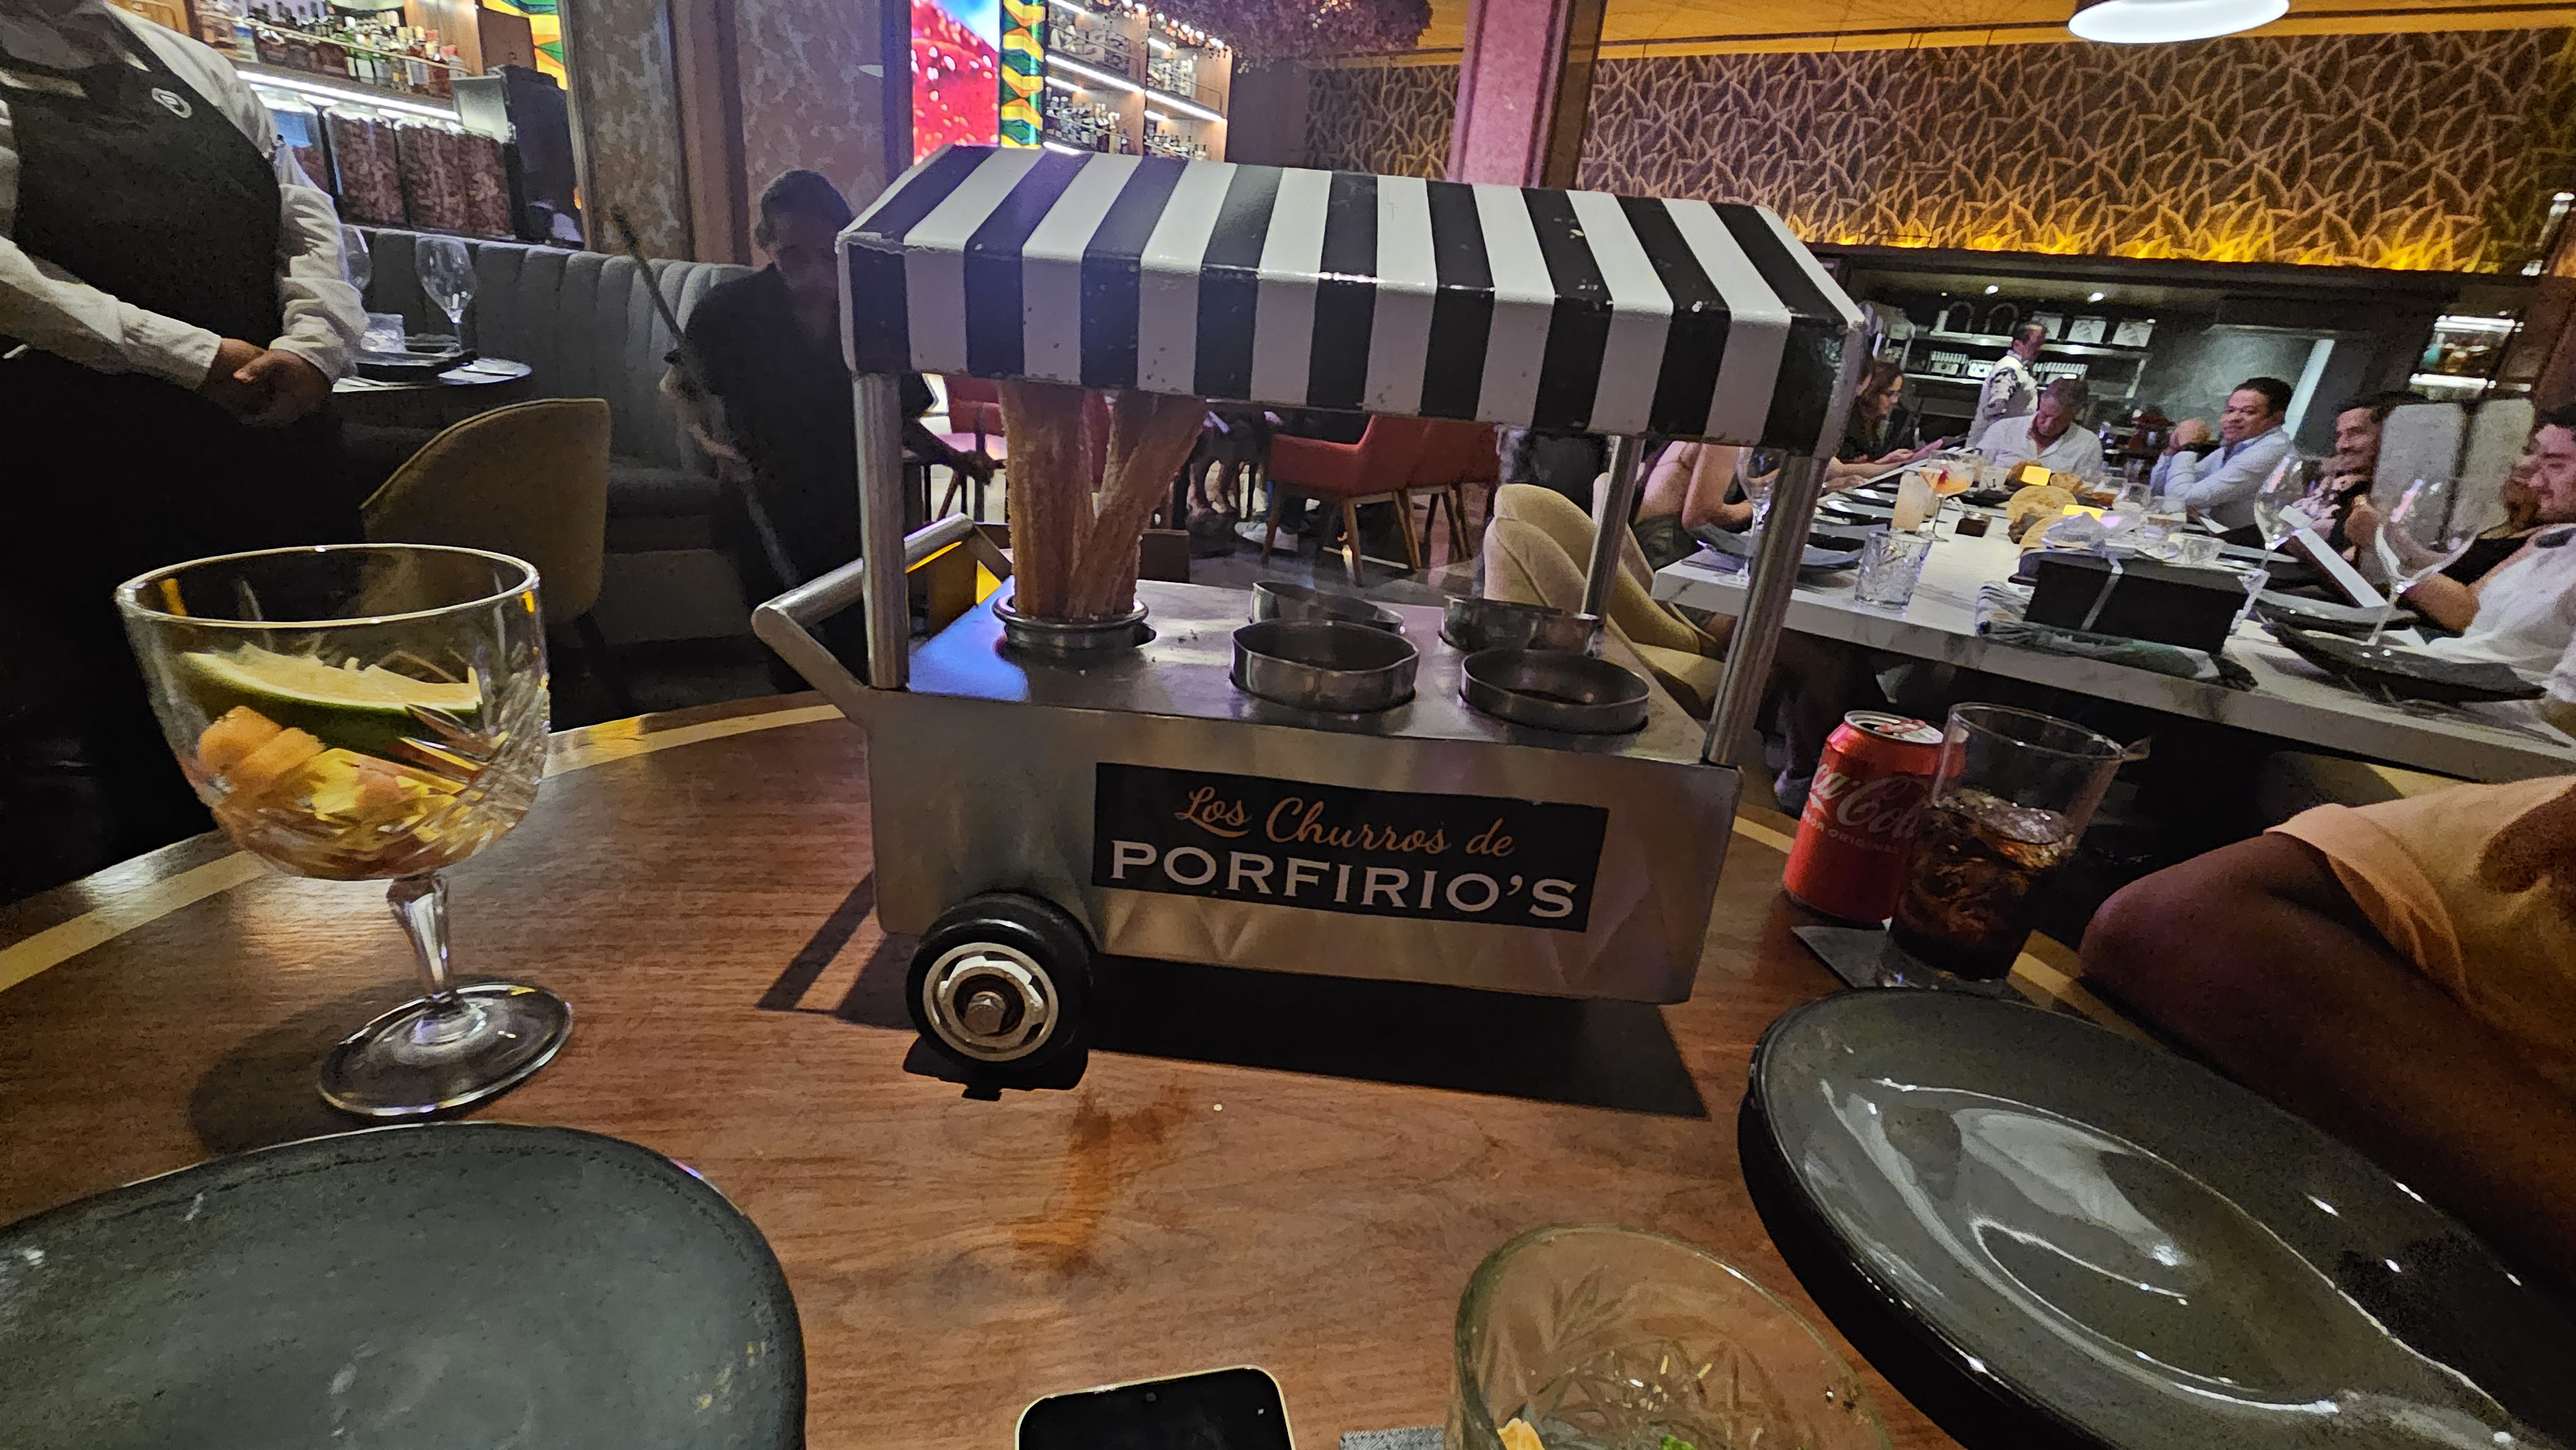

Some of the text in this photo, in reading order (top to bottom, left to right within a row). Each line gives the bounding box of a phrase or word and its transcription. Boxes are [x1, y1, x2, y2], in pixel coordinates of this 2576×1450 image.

[1173, 786, 1515, 858] Los Churros de
[1110, 840, 1578, 918] PORFIRIO'S
